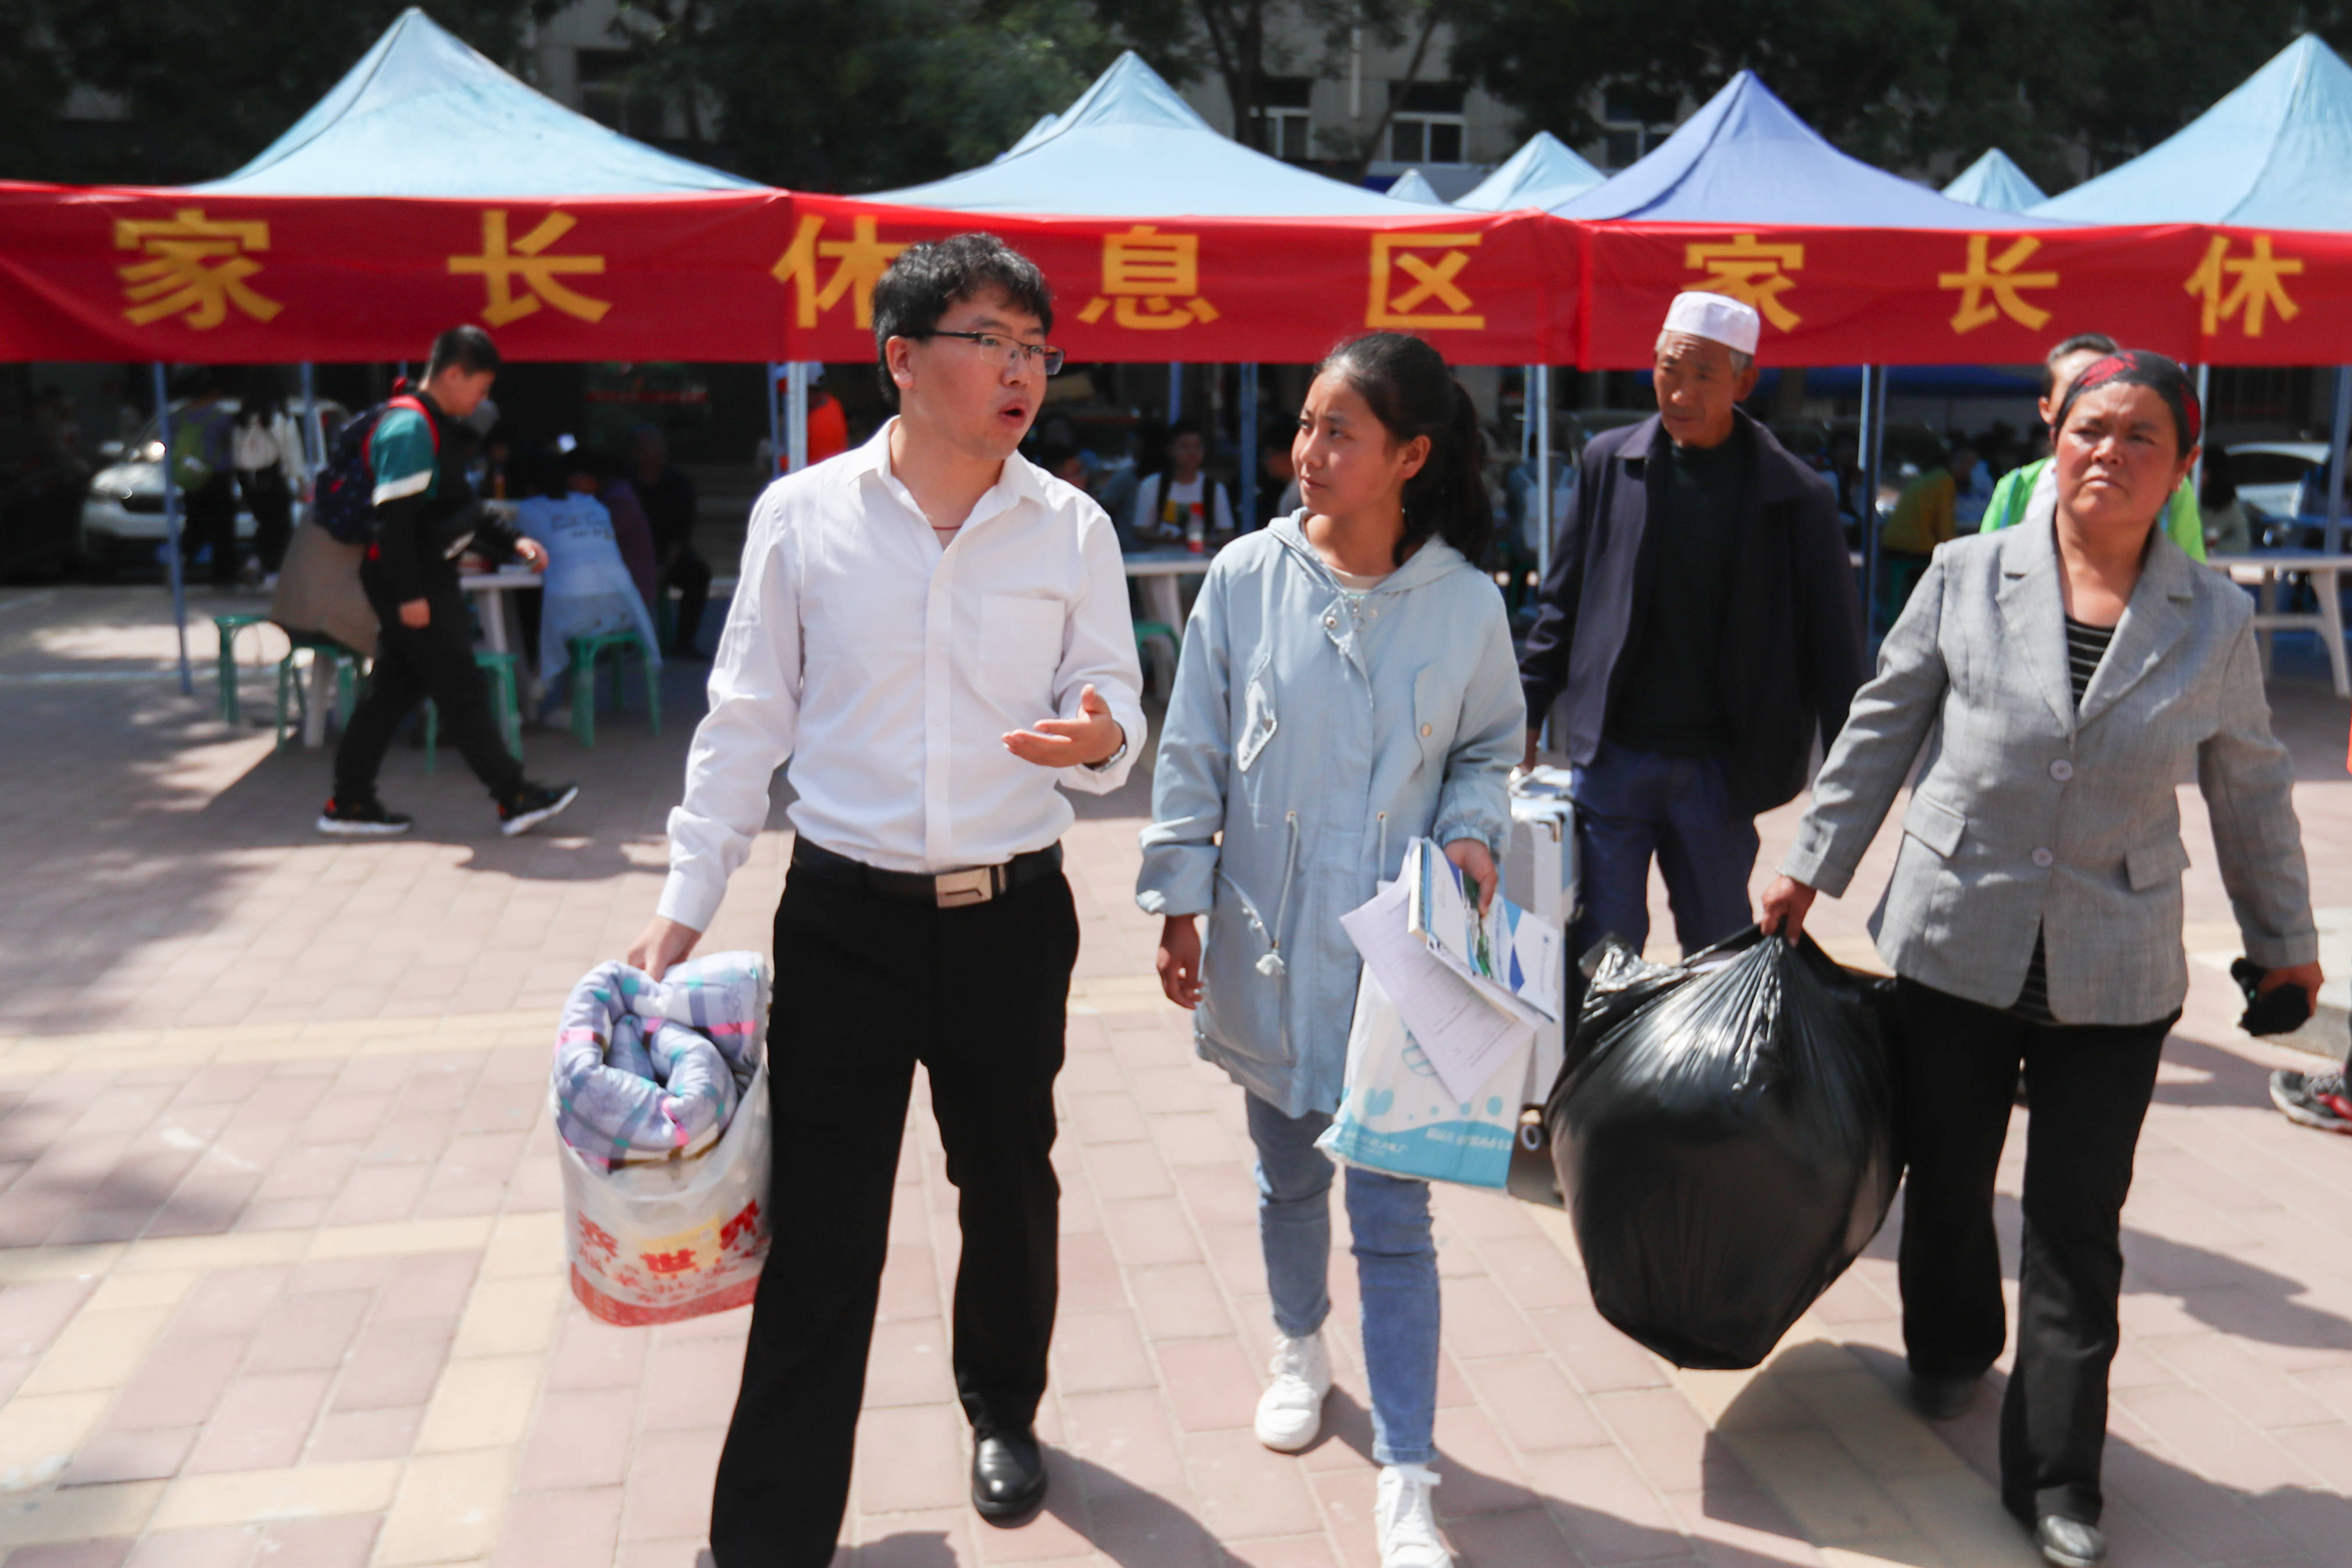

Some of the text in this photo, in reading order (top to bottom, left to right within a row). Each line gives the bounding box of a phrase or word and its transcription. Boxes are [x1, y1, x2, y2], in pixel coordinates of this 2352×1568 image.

[115, 208, 1486, 330] 家长休息区
